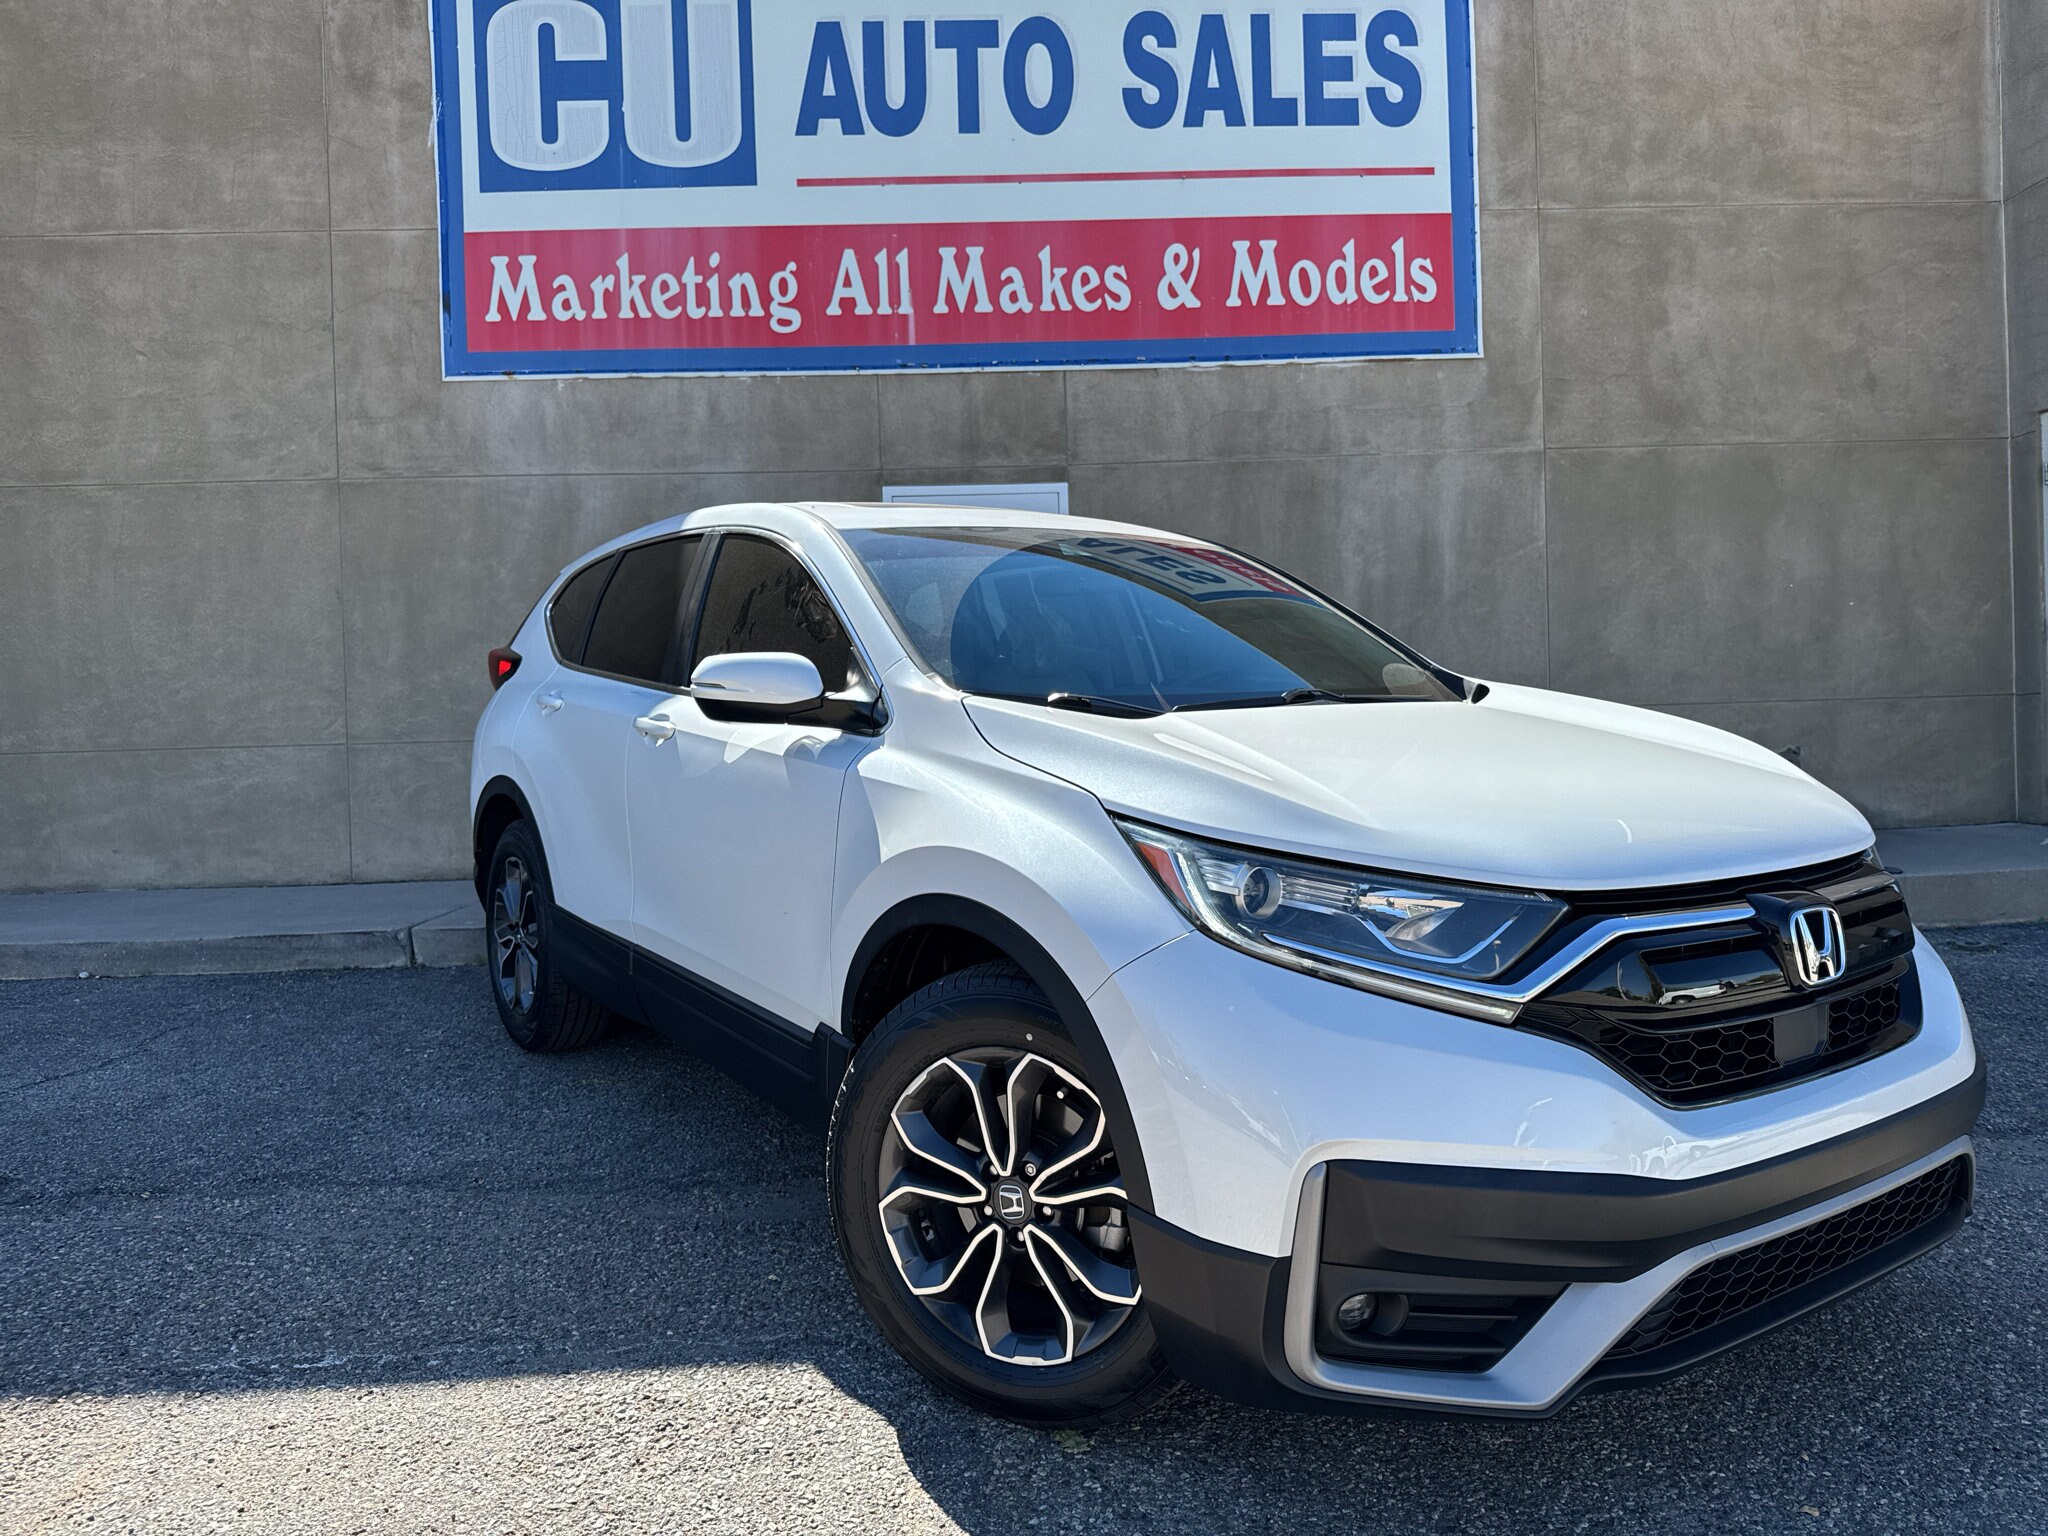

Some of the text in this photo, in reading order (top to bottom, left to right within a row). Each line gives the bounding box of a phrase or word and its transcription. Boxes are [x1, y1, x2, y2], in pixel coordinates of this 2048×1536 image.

[486, 0, 743, 171] CU
[795, 9, 1423, 137] AUTO SALES
[485, 236, 1438, 333] Marketing All Makes & Models
